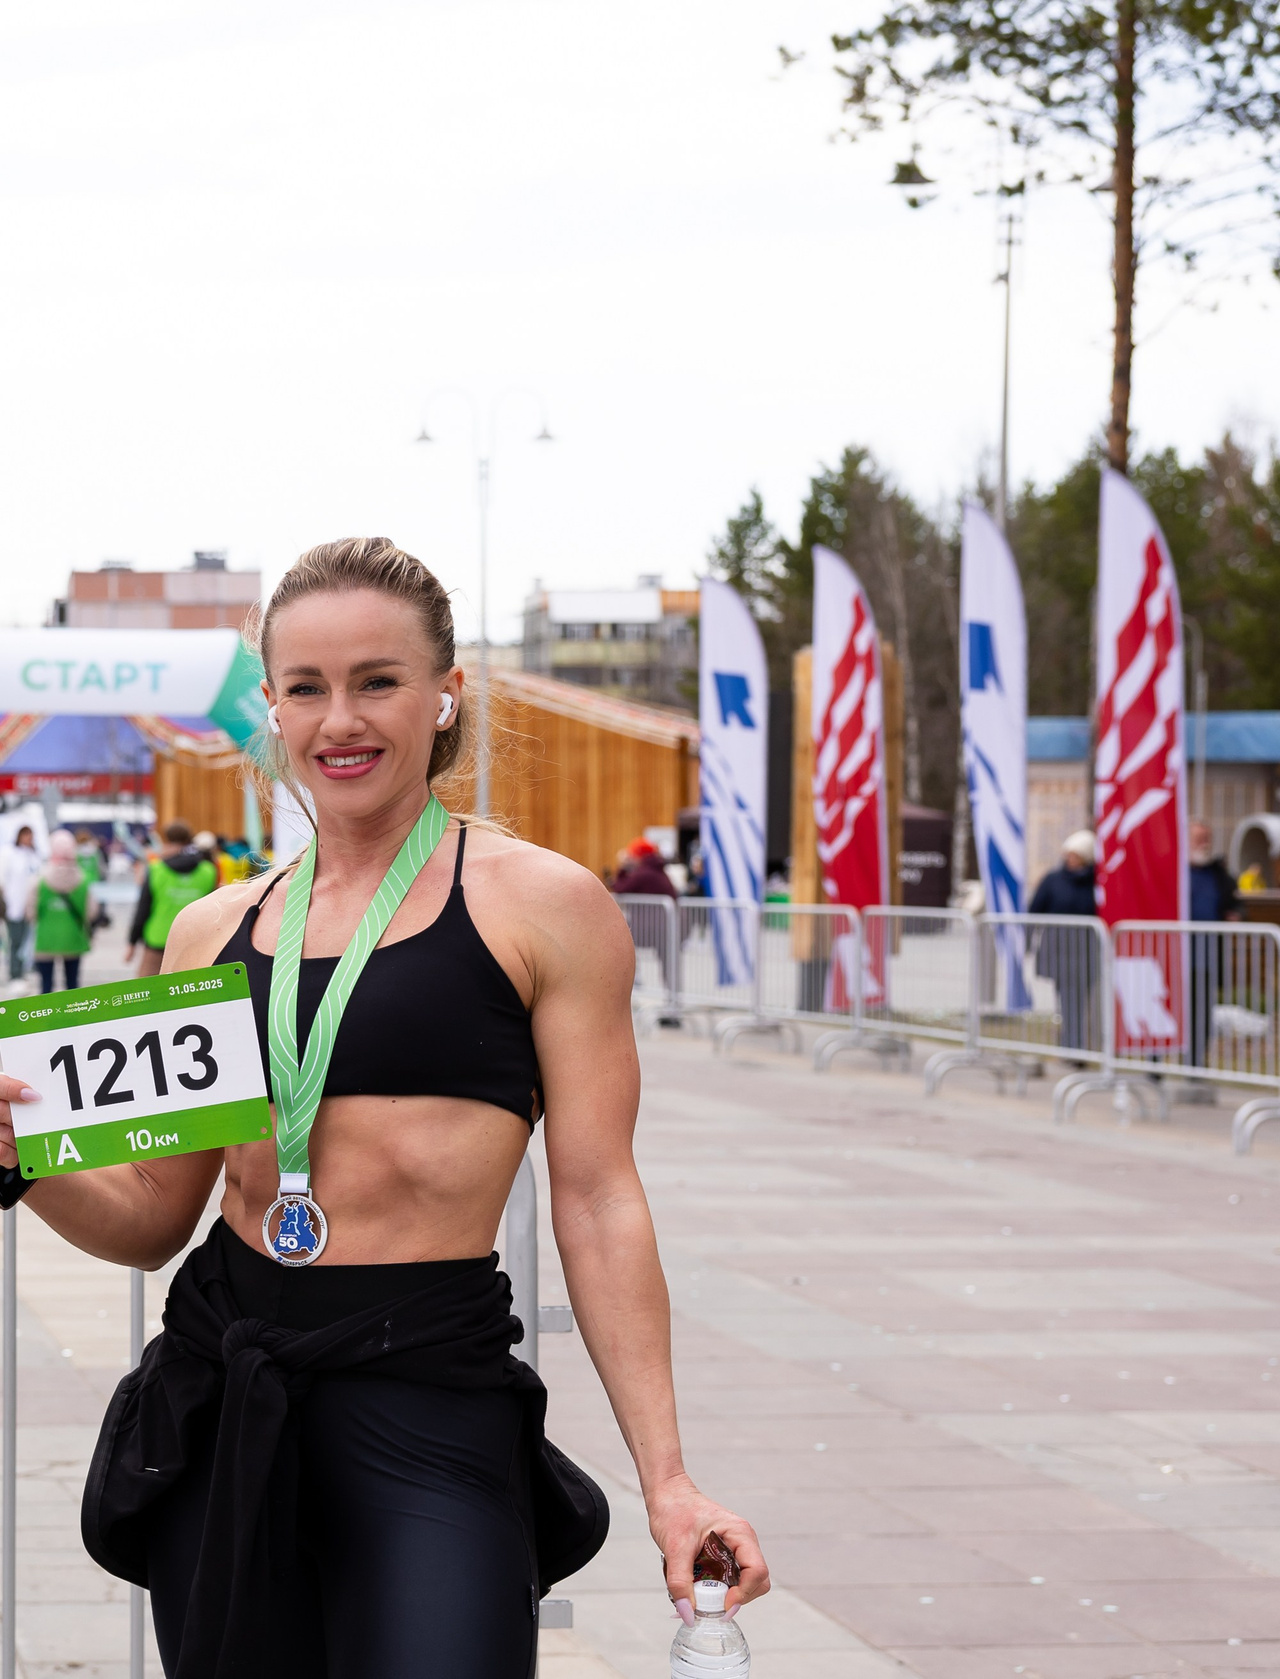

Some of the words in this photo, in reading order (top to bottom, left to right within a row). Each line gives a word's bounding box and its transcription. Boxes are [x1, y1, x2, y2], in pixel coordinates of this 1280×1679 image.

[21, 660, 167, 692] СТАРТ
[169, 978, 223, 996] 31.05.2025
[123, 990, 150, 1001] ЦЕНТР
[30, 1008, 53, 1018] СБЕР
[49, 1024, 219, 1111] 1213
[279, 1237, 298, 1249] 50
